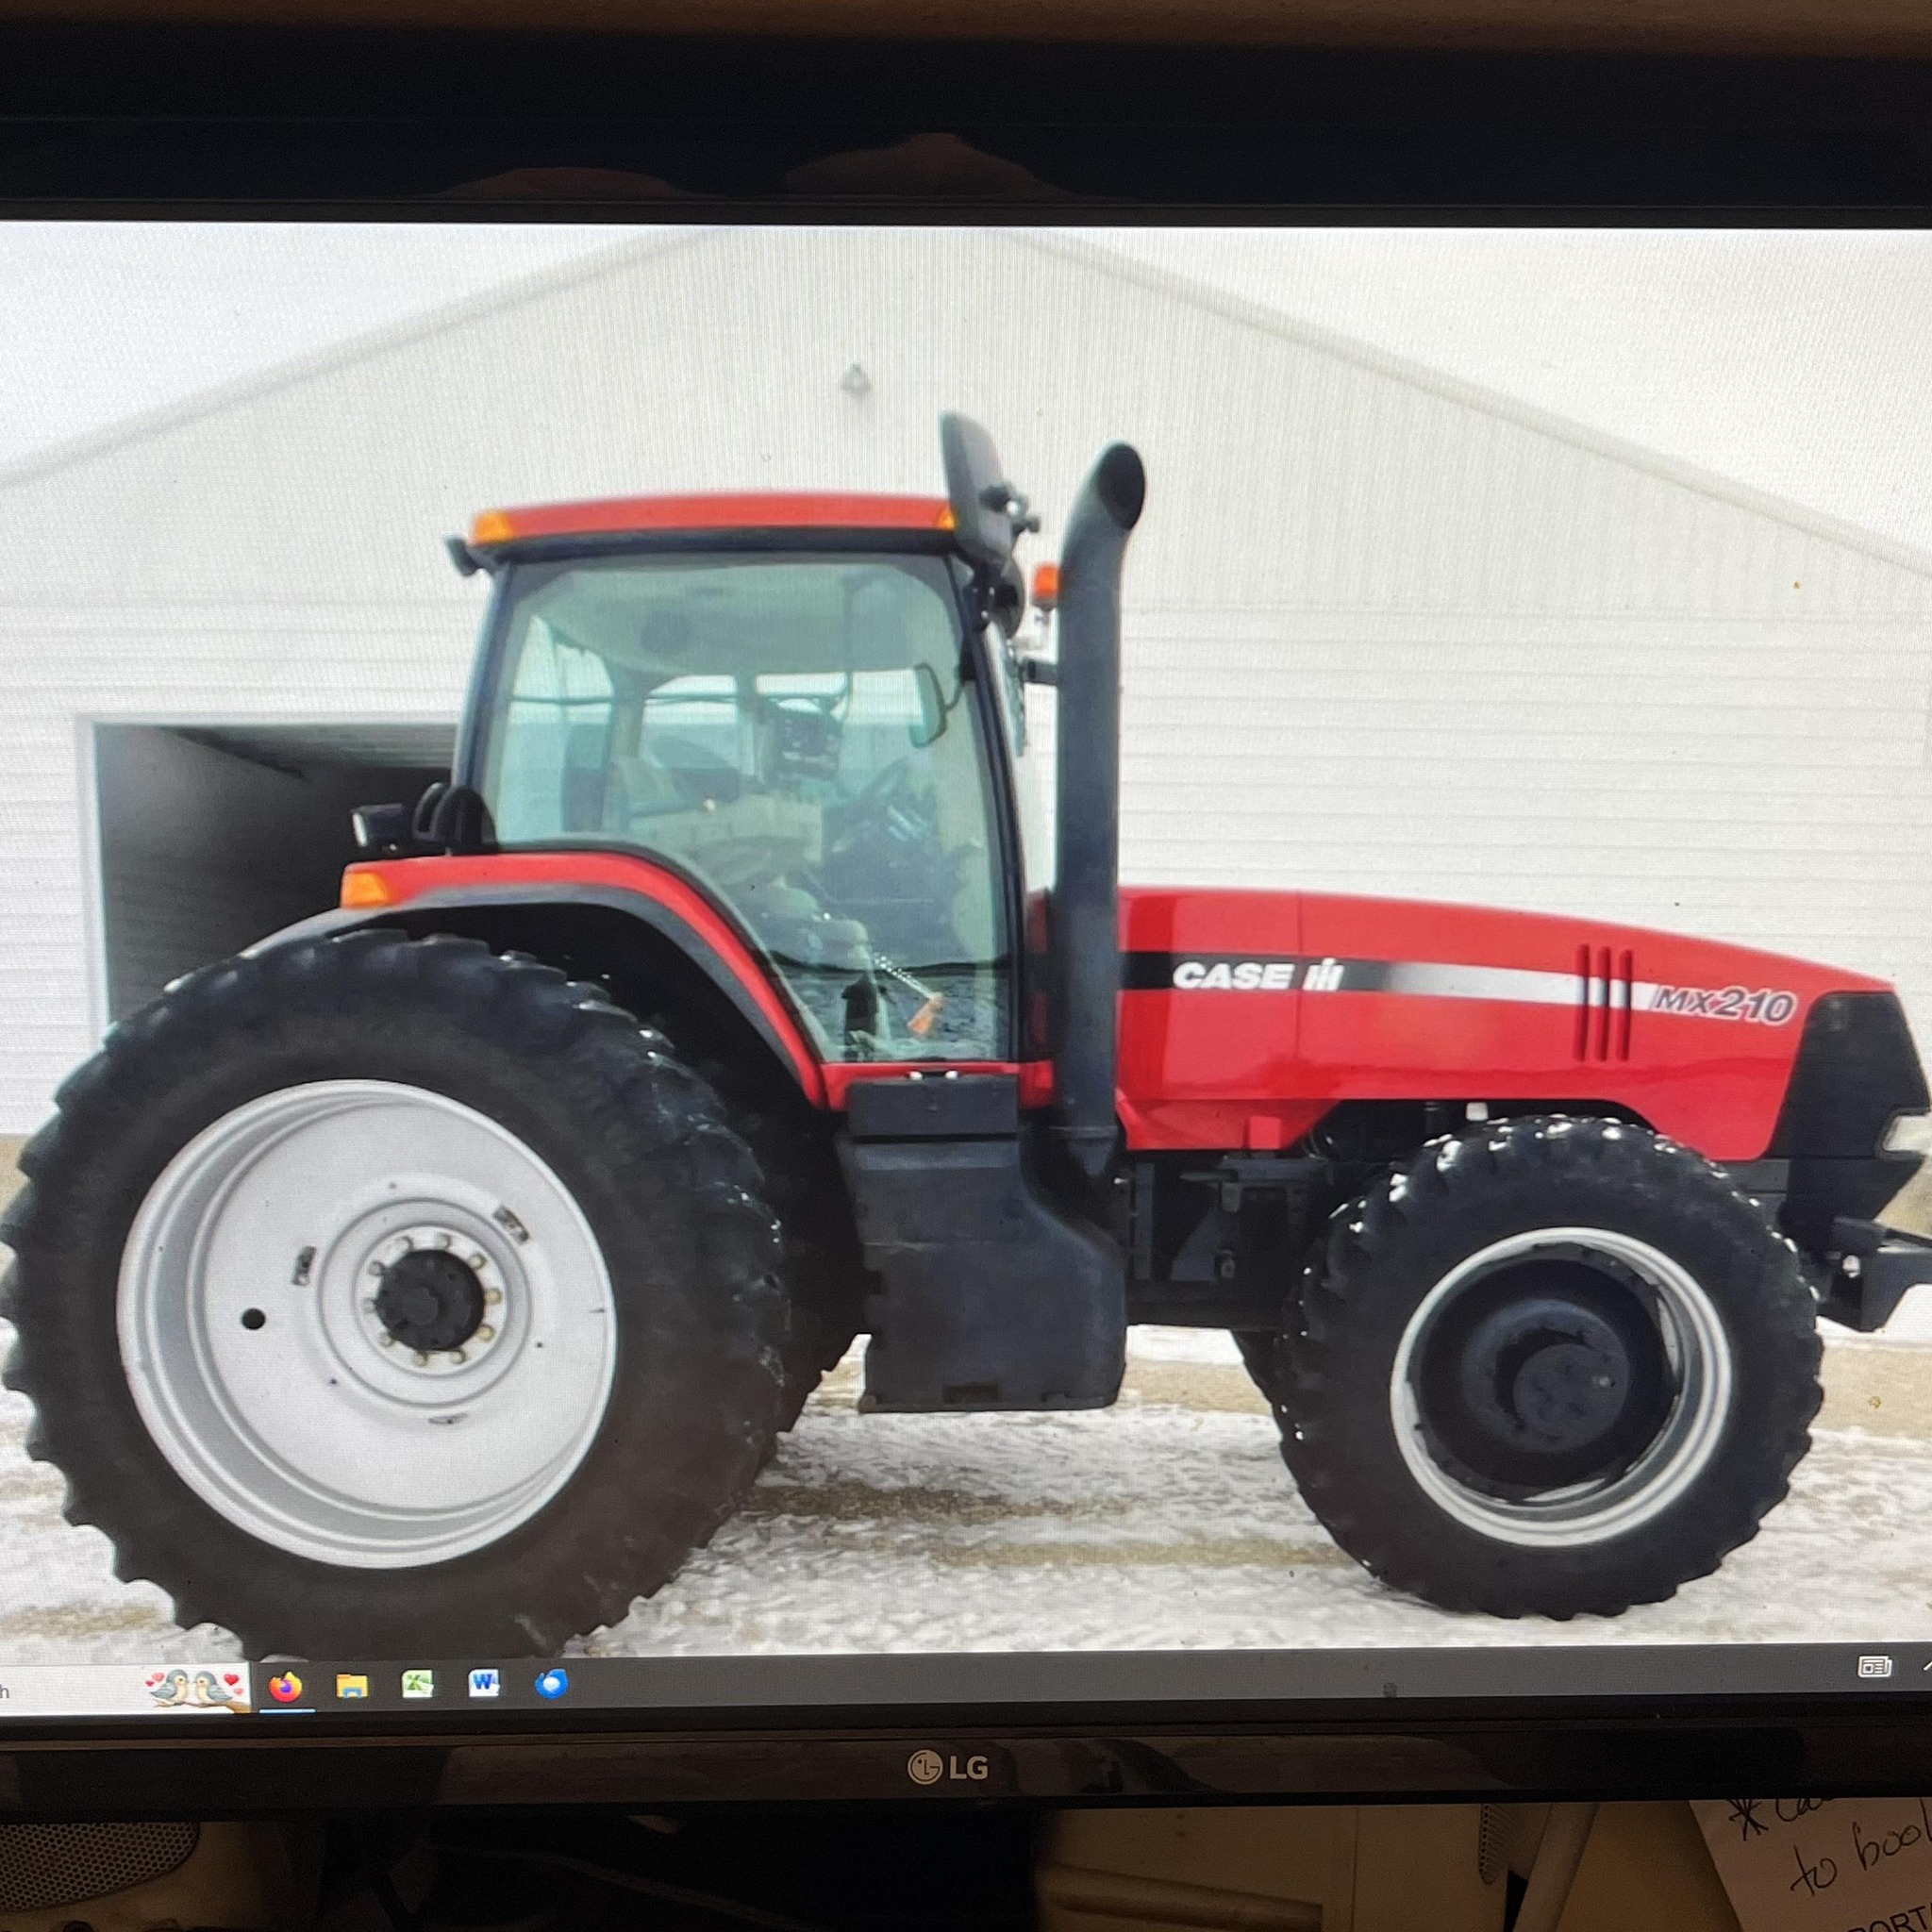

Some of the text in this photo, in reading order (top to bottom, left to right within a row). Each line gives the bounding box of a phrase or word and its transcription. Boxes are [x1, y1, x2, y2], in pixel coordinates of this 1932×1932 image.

[1173, 961, 1295, 990] CASE
[1653, 985, 1797, 1025] MX210
[949, 1755, 989, 1780] LG
[1790, 1845, 1838, 1896] to
